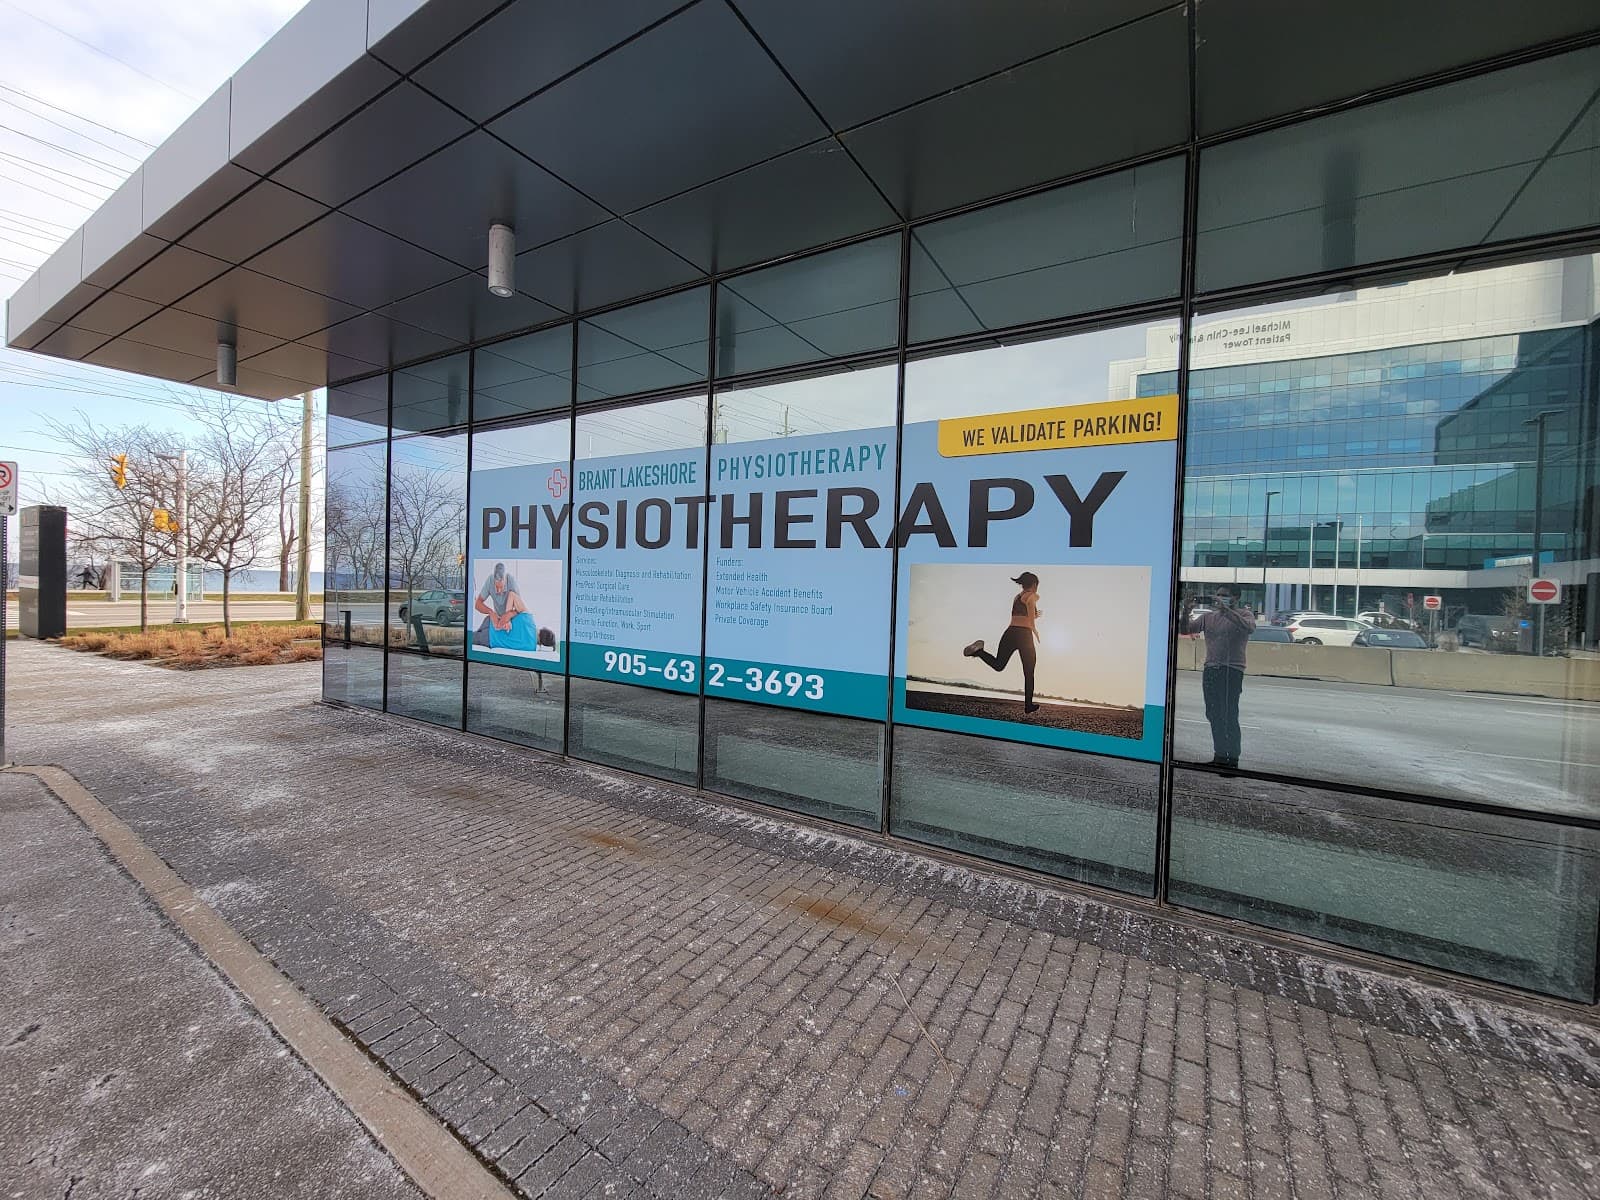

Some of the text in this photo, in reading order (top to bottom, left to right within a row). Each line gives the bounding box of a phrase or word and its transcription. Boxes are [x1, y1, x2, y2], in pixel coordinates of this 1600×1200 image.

[963, 411, 1162, 448] WE VALIDATE PARKING!
[579, 443, 888, 491] BRANT LAKESHORE PHYSIOTHERAPY
[481, 470, 1128, 550] PHYSIOTHERAPY
[717, 571, 768, 582] Extended Health
[716, 586, 823, 600] Motor Vehicle Accident Benefits
[716, 600, 833, 616] Workplace Safety Insurance Board
[715, 613, 769, 628] Private Coverage
